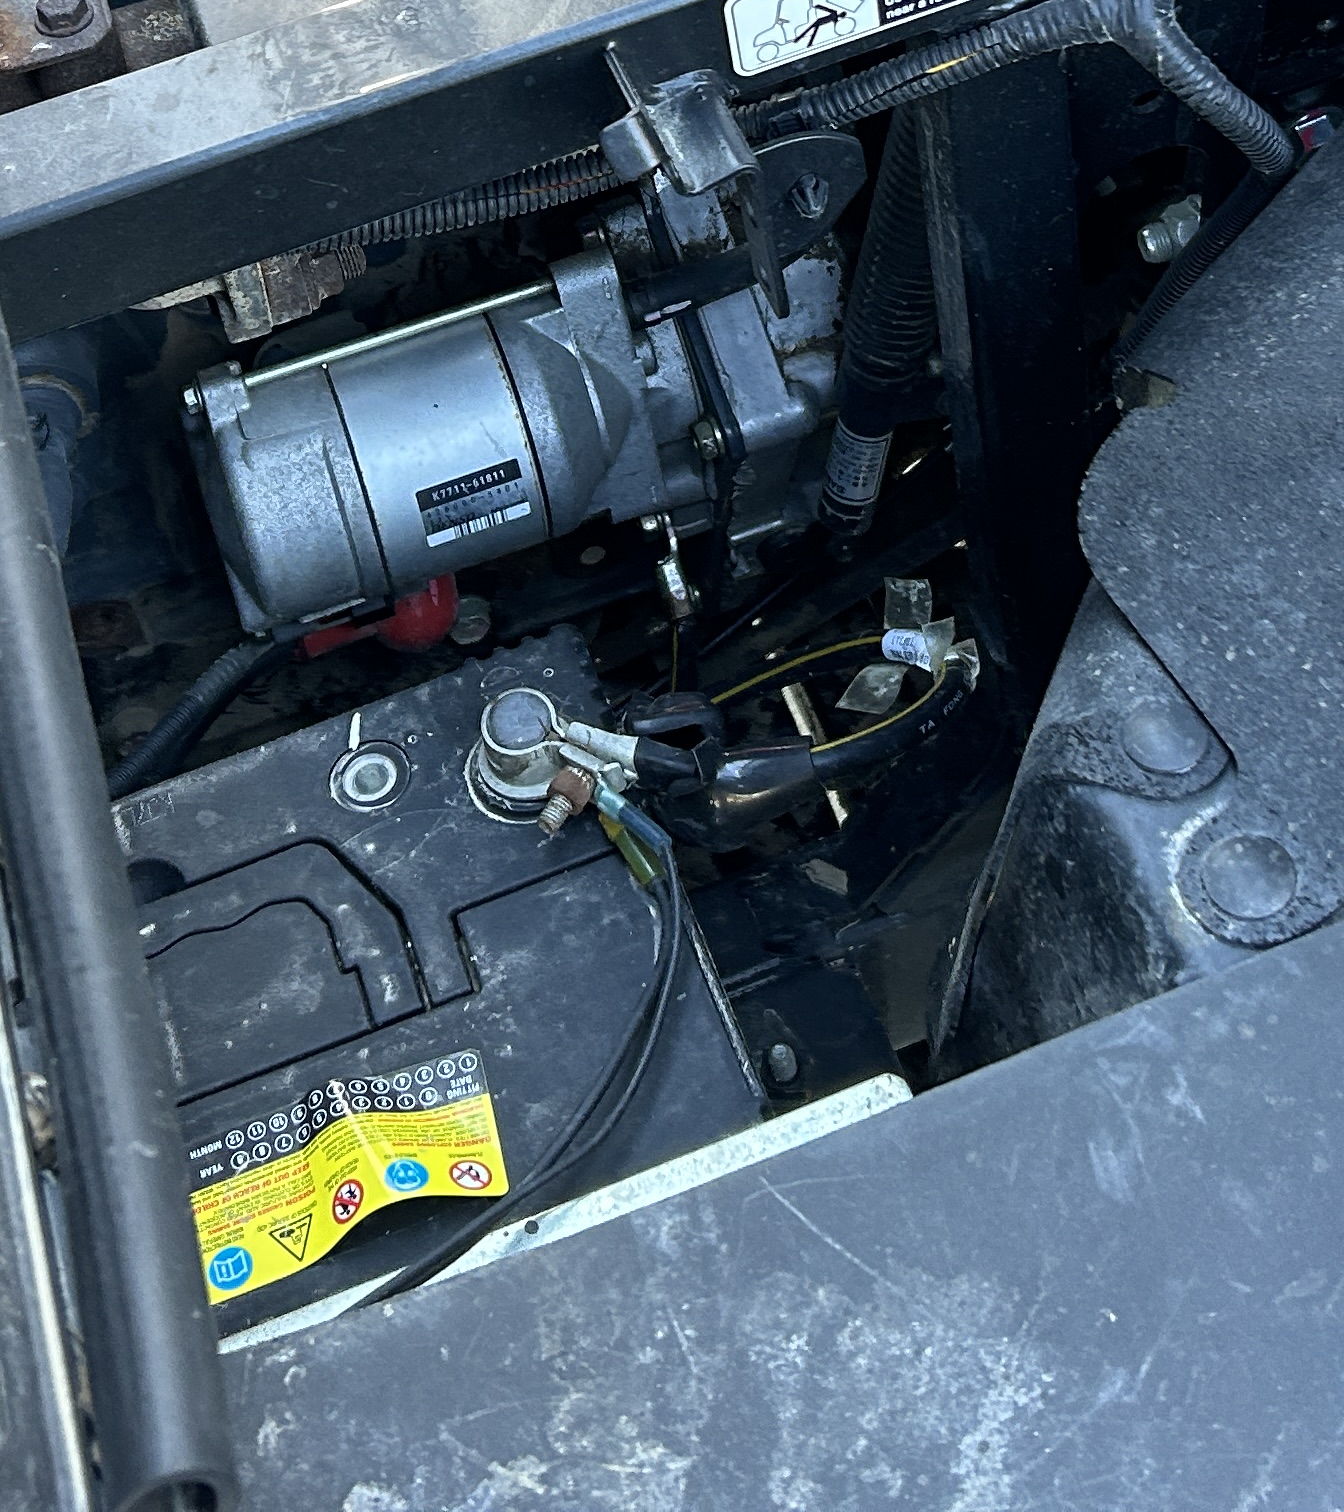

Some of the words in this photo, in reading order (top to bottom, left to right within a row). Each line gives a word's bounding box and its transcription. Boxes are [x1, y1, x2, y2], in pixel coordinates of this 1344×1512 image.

[886, 3, 915, 19] near
[917, 0, 927, 8] a
[431, 469, 506, 501] K7711-61811
[449, 1074, 473, 1088] DATE
[189, 1140, 223, 1160] MONTH
[199, 1163, 224, 1179] YEAR
[291, 1160, 310, 1177] KEEP
[273, 1173, 290, 1184] OUT
